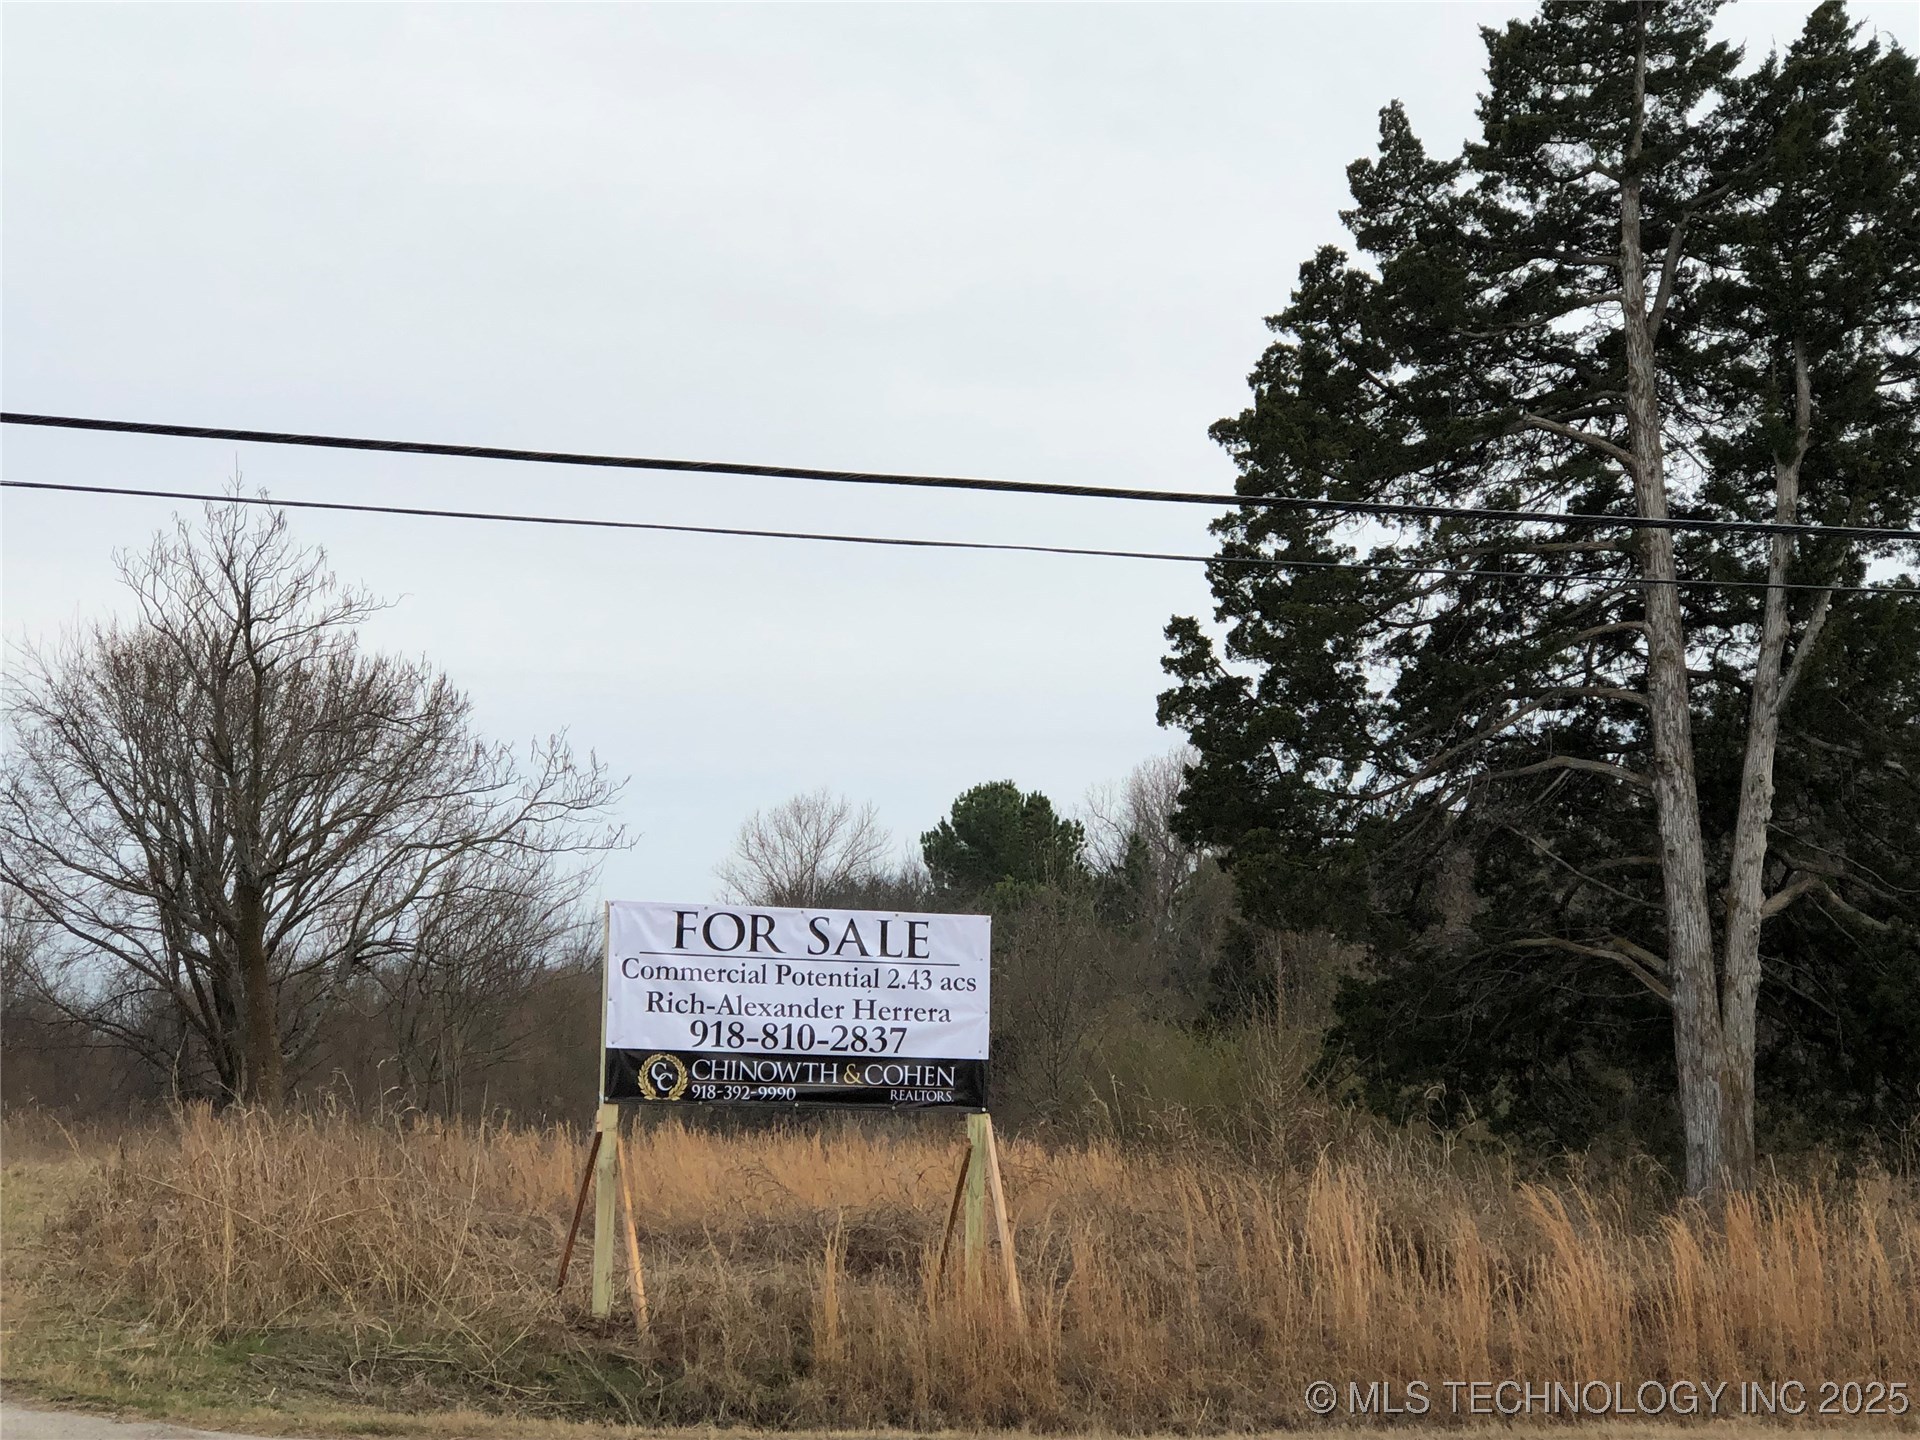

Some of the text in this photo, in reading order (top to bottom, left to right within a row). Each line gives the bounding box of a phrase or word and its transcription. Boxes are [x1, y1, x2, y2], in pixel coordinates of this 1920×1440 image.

[671, 910, 930, 959] FOR SALE
[621, 957, 977, 992] Commercial Potential 2.43 acs
[645, 991, 951, 1023] Rich-Alexander Herrera
[689, 1020, 908, 1054] 918-810-2837
[691, 1084, 797, 1100] 918-392-9990
[864, 1064, 956, 1087] COHEN
